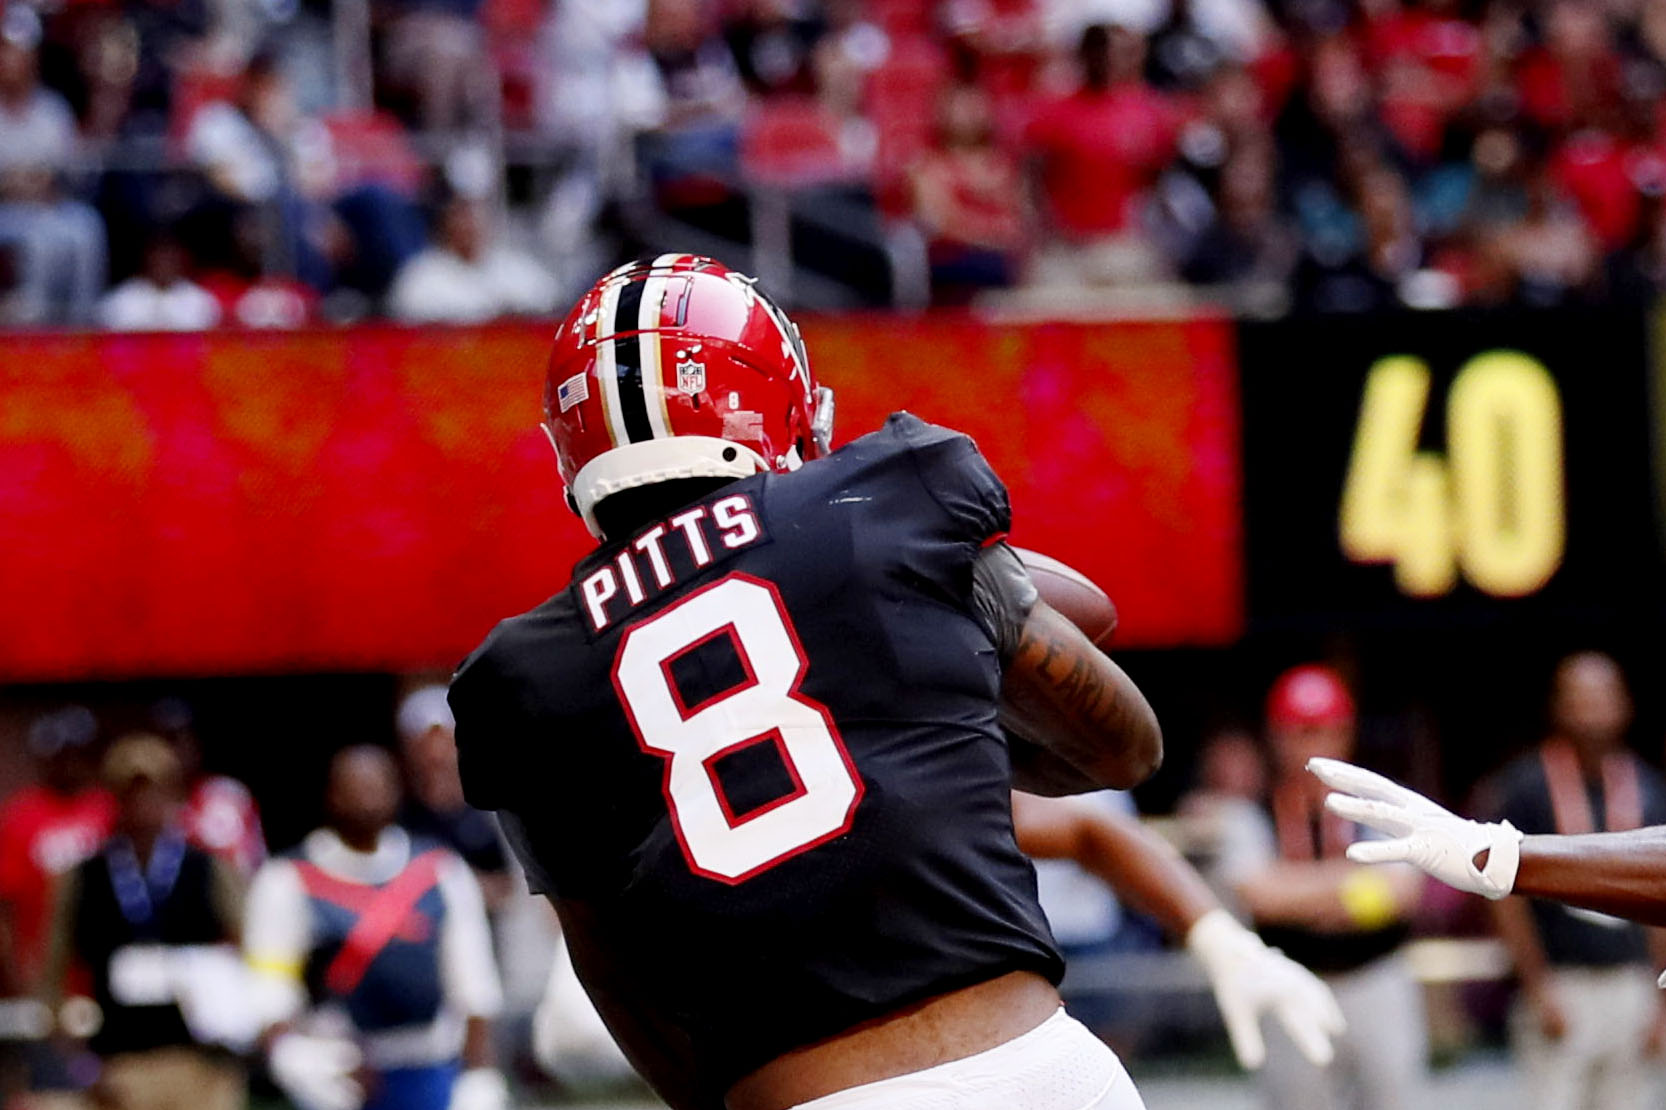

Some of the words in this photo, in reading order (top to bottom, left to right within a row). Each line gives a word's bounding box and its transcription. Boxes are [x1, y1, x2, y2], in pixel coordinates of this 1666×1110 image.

[682, 376, 702, 391] NFL
[728, 392, 739, 409] 8
[1338, 350, 1566, 597] 40
[580, 494, 761, 632] PITTS
[609, 570, 866, 886] 8
